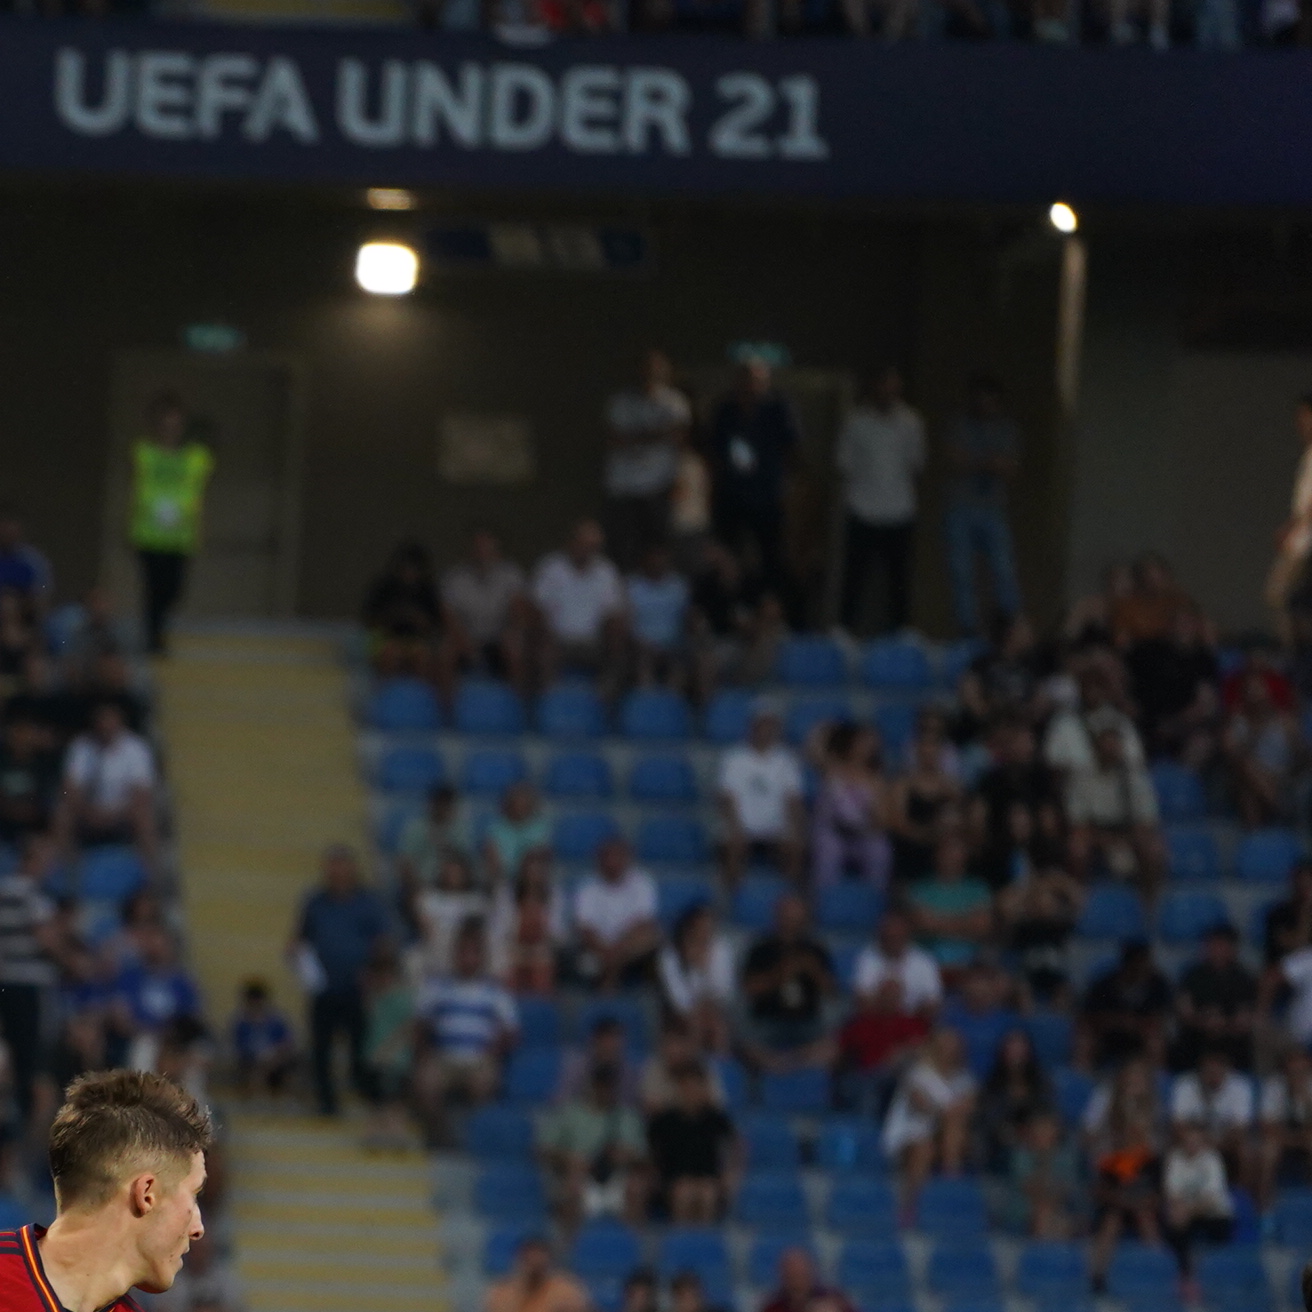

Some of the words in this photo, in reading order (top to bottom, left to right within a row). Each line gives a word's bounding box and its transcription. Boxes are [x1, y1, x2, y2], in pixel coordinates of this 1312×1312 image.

[54, 48, 318, 144] UEFA
[336, 58, 692, 155] UNDER
[710, 74, 828, 160] 21
